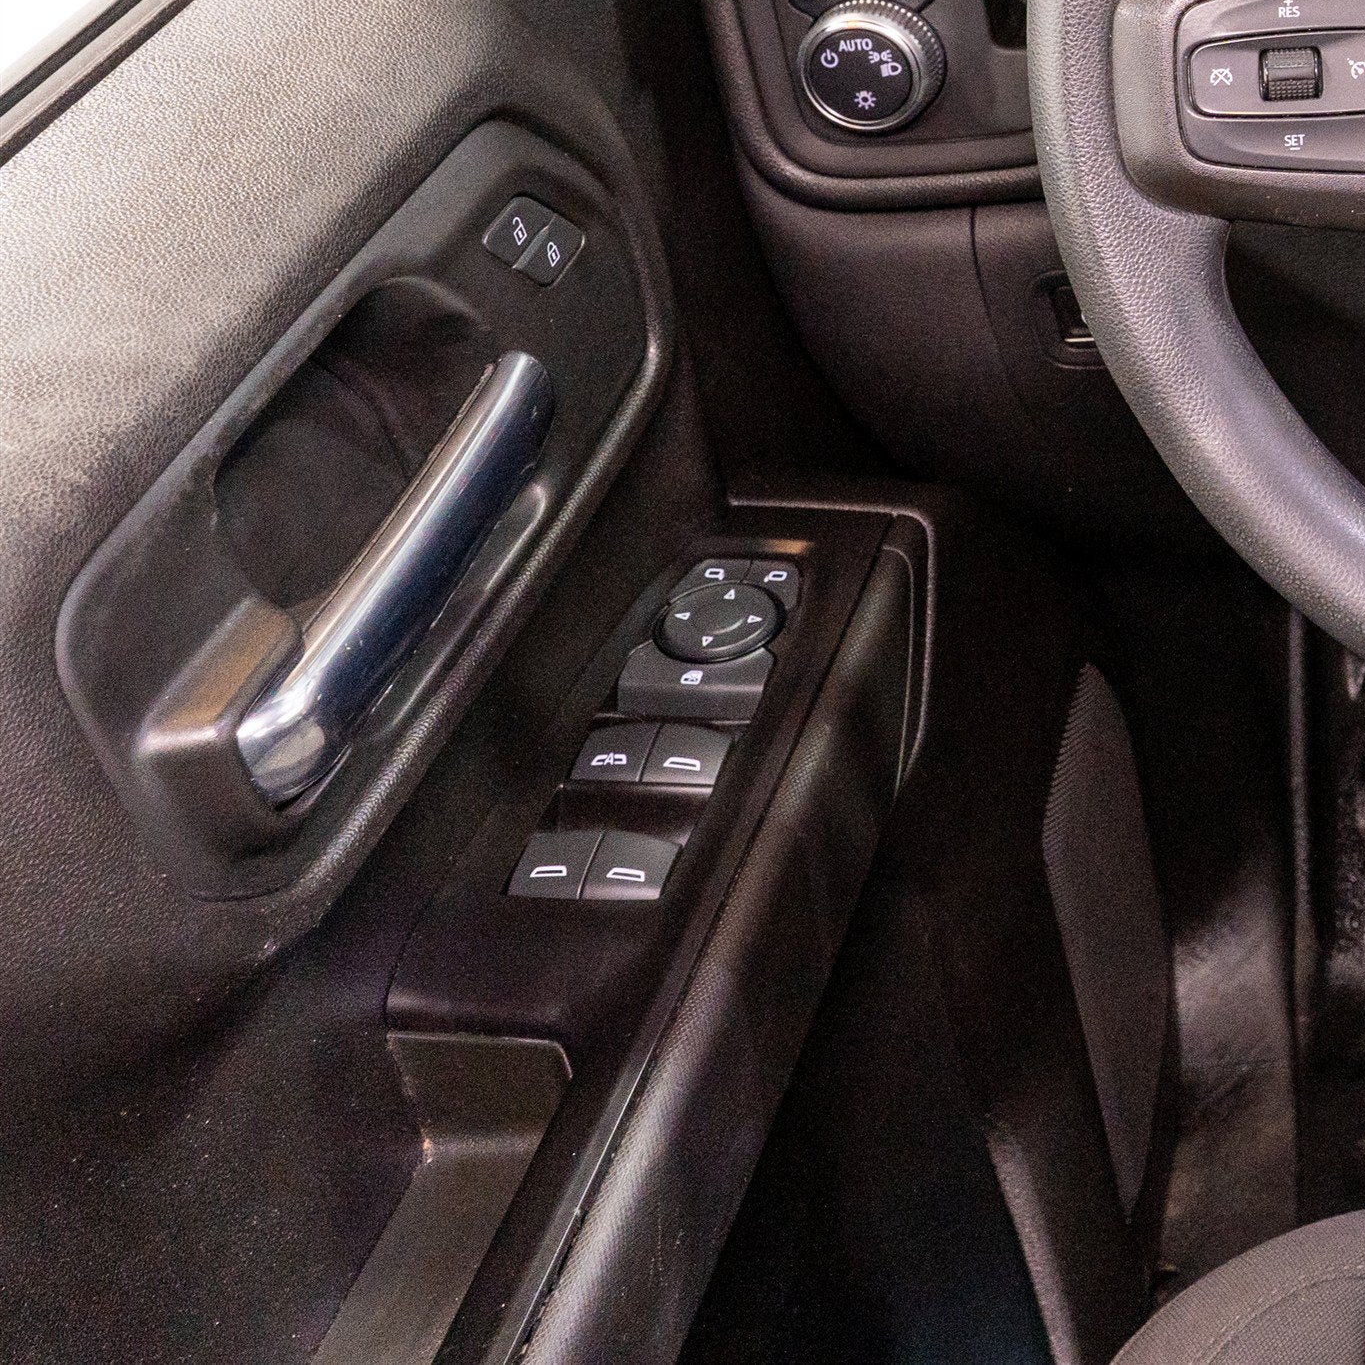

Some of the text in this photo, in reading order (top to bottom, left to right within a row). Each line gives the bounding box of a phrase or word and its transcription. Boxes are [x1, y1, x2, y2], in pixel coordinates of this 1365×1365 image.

[1278, 6, 1301, 18] RES
[838, 37, 873, 53] AUTO
[1284, 134, 1306, 148] SET
